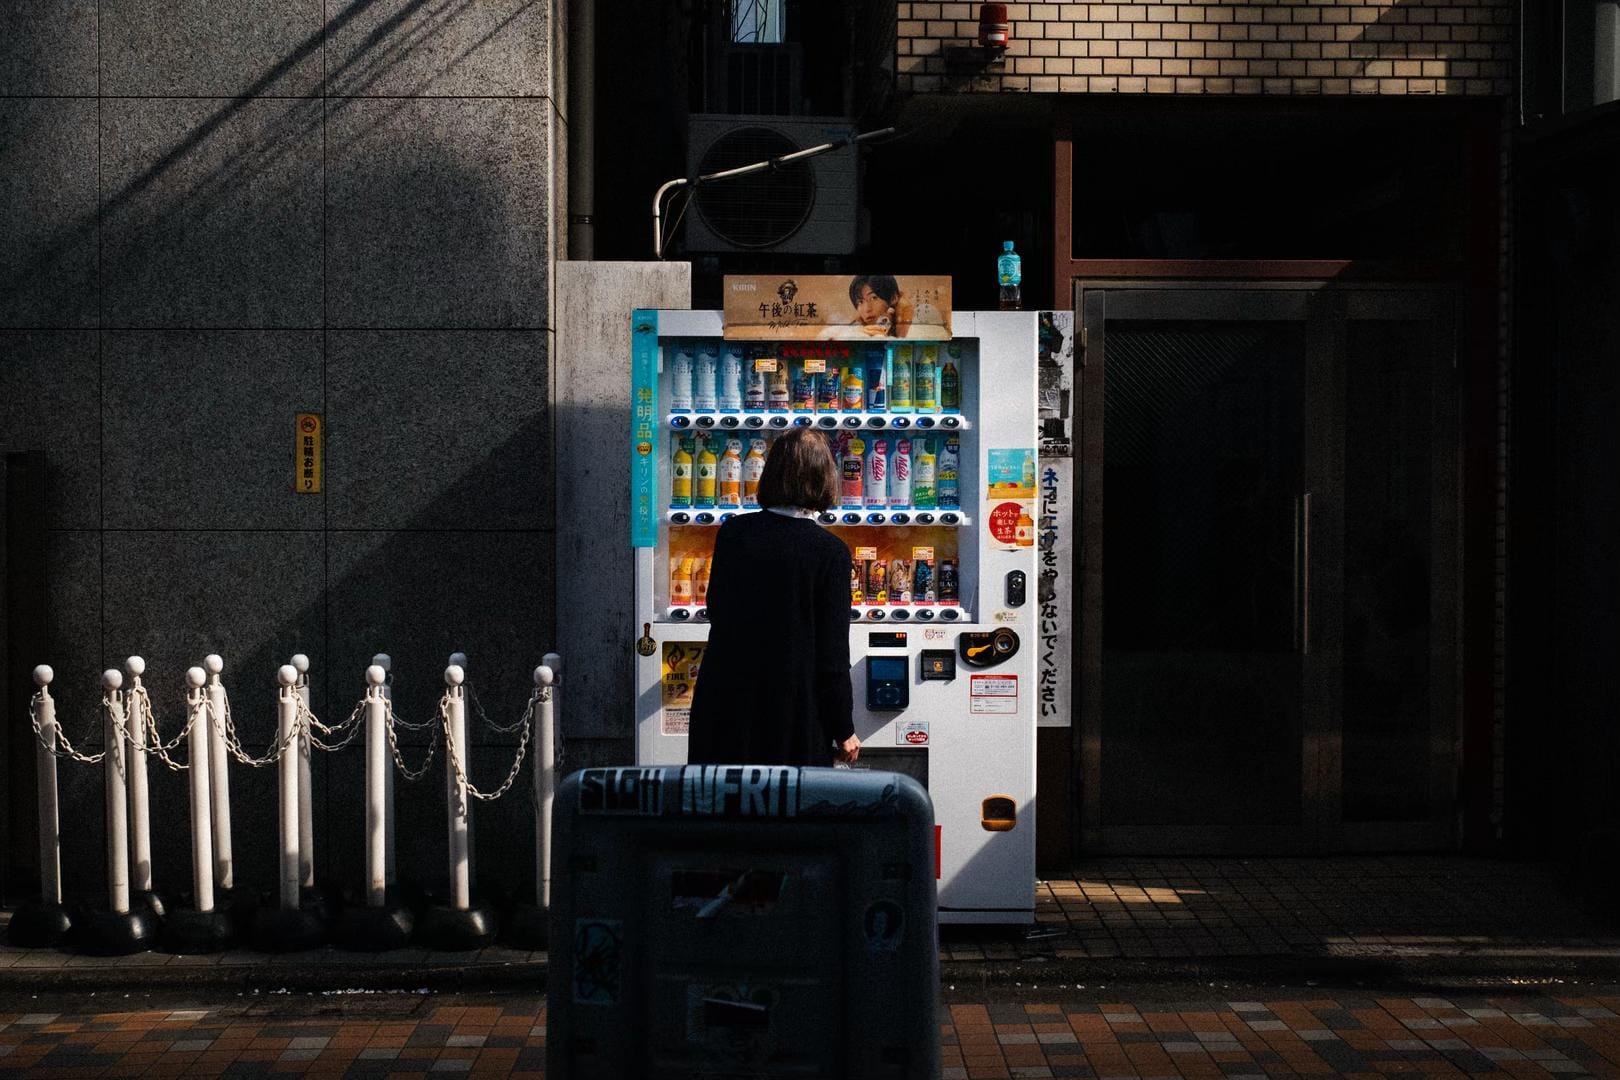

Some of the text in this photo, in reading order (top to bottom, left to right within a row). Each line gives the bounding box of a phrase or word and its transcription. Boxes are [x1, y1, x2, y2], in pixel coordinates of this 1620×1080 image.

[732, 284, 756, 292] KIRIN
[758, 302, 818, 319] 午後の紅茶
